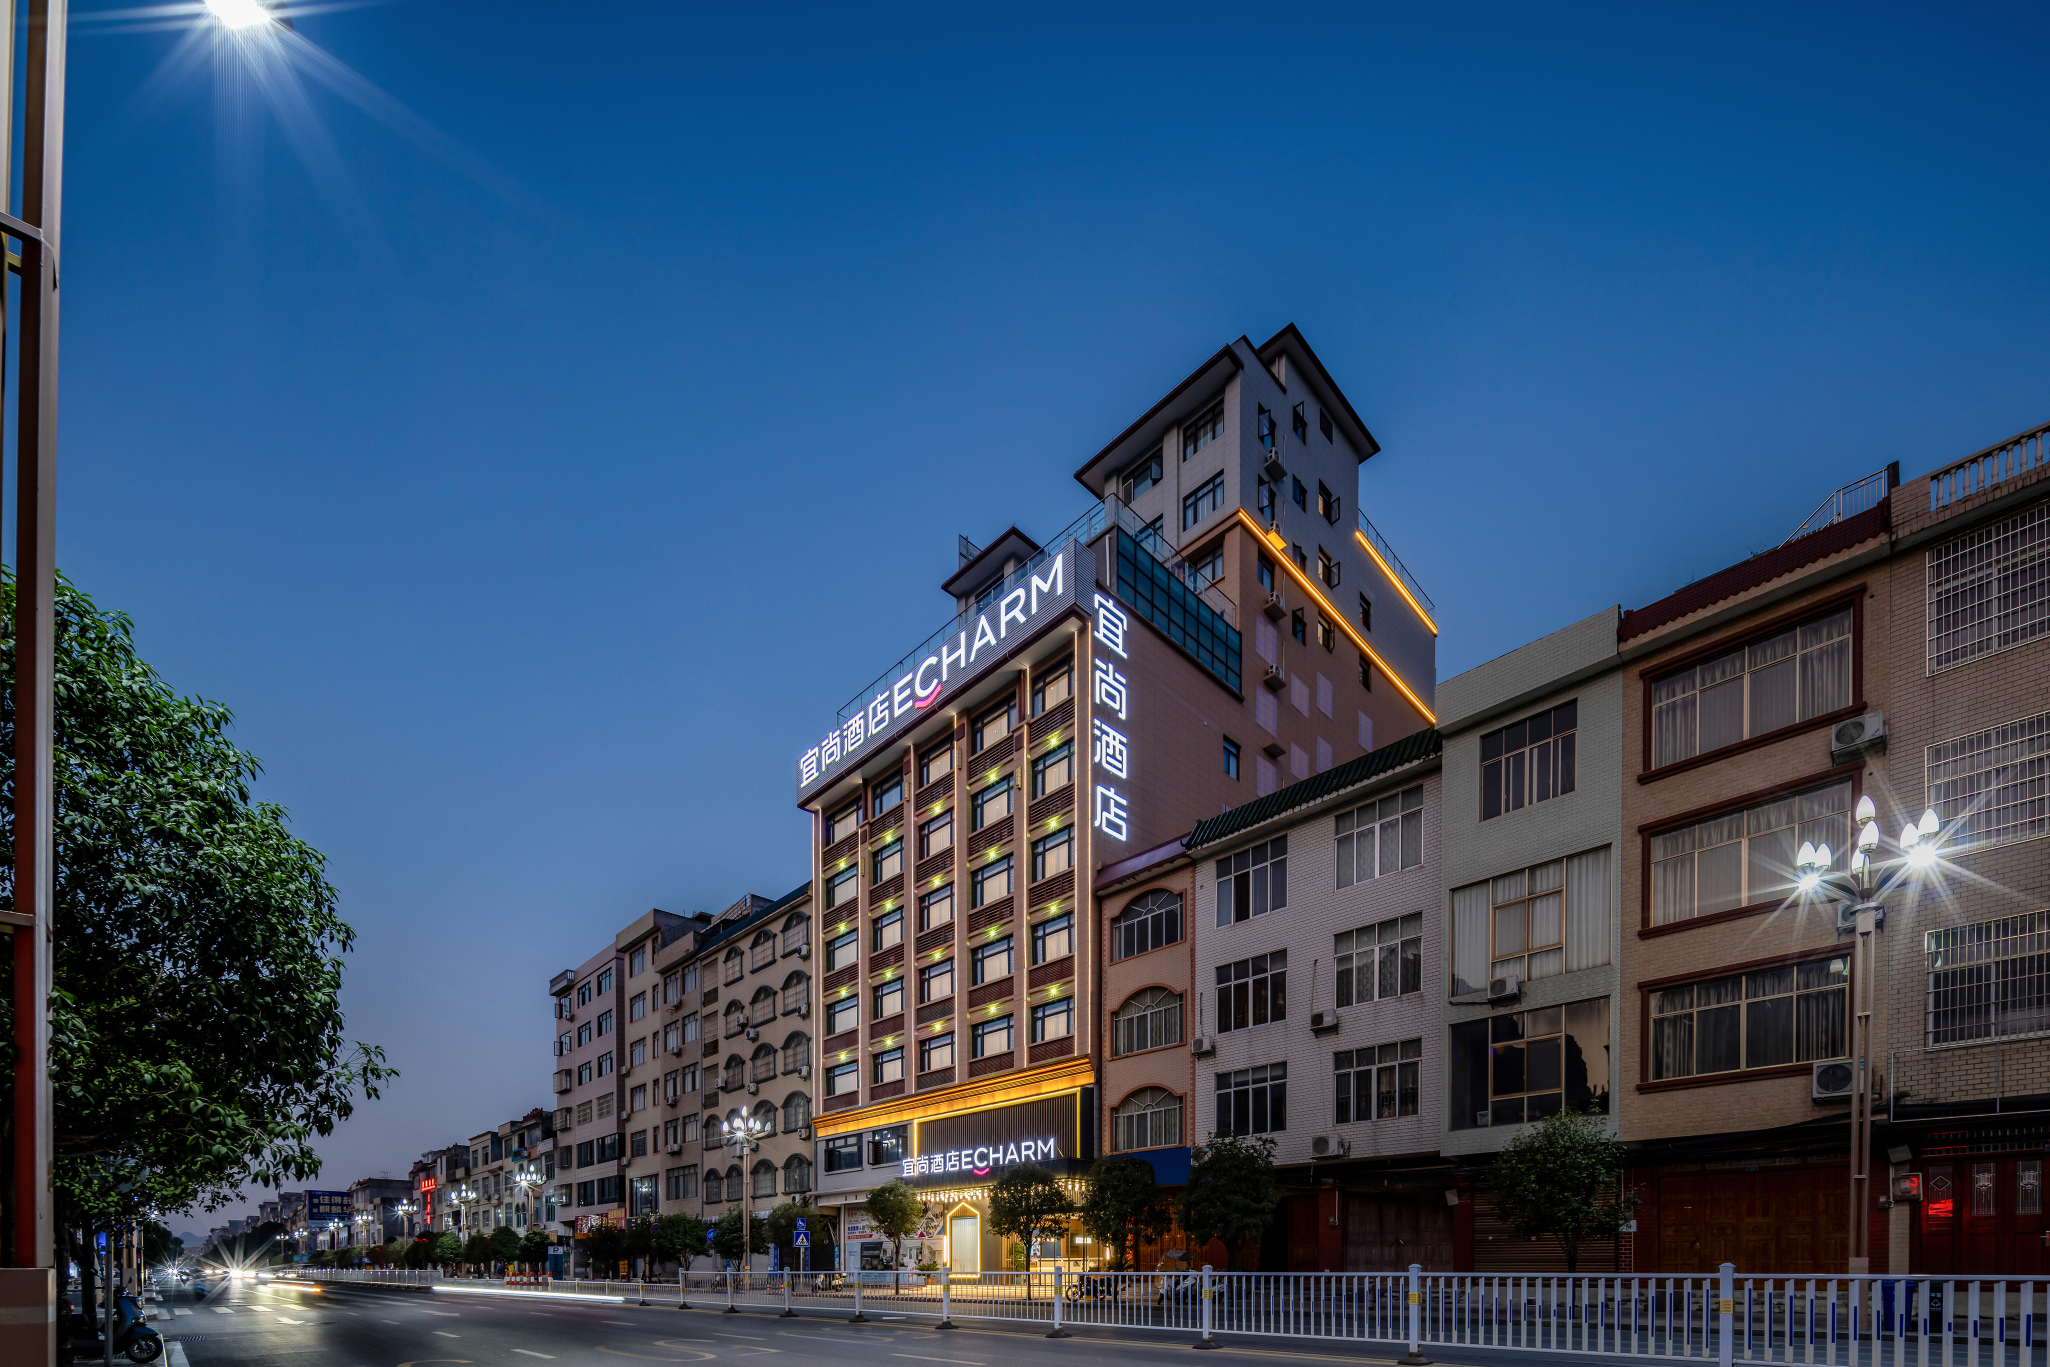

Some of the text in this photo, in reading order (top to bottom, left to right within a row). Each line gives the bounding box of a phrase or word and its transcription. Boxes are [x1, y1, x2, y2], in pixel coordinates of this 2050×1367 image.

[800, 553, 1063, 788] 宜尚酒店 ECHARM
[1094, 593, 1127, 841] 宜尚酒店
[902, 1138, 1055, 1177] 宜尚酒店 ECHARM
